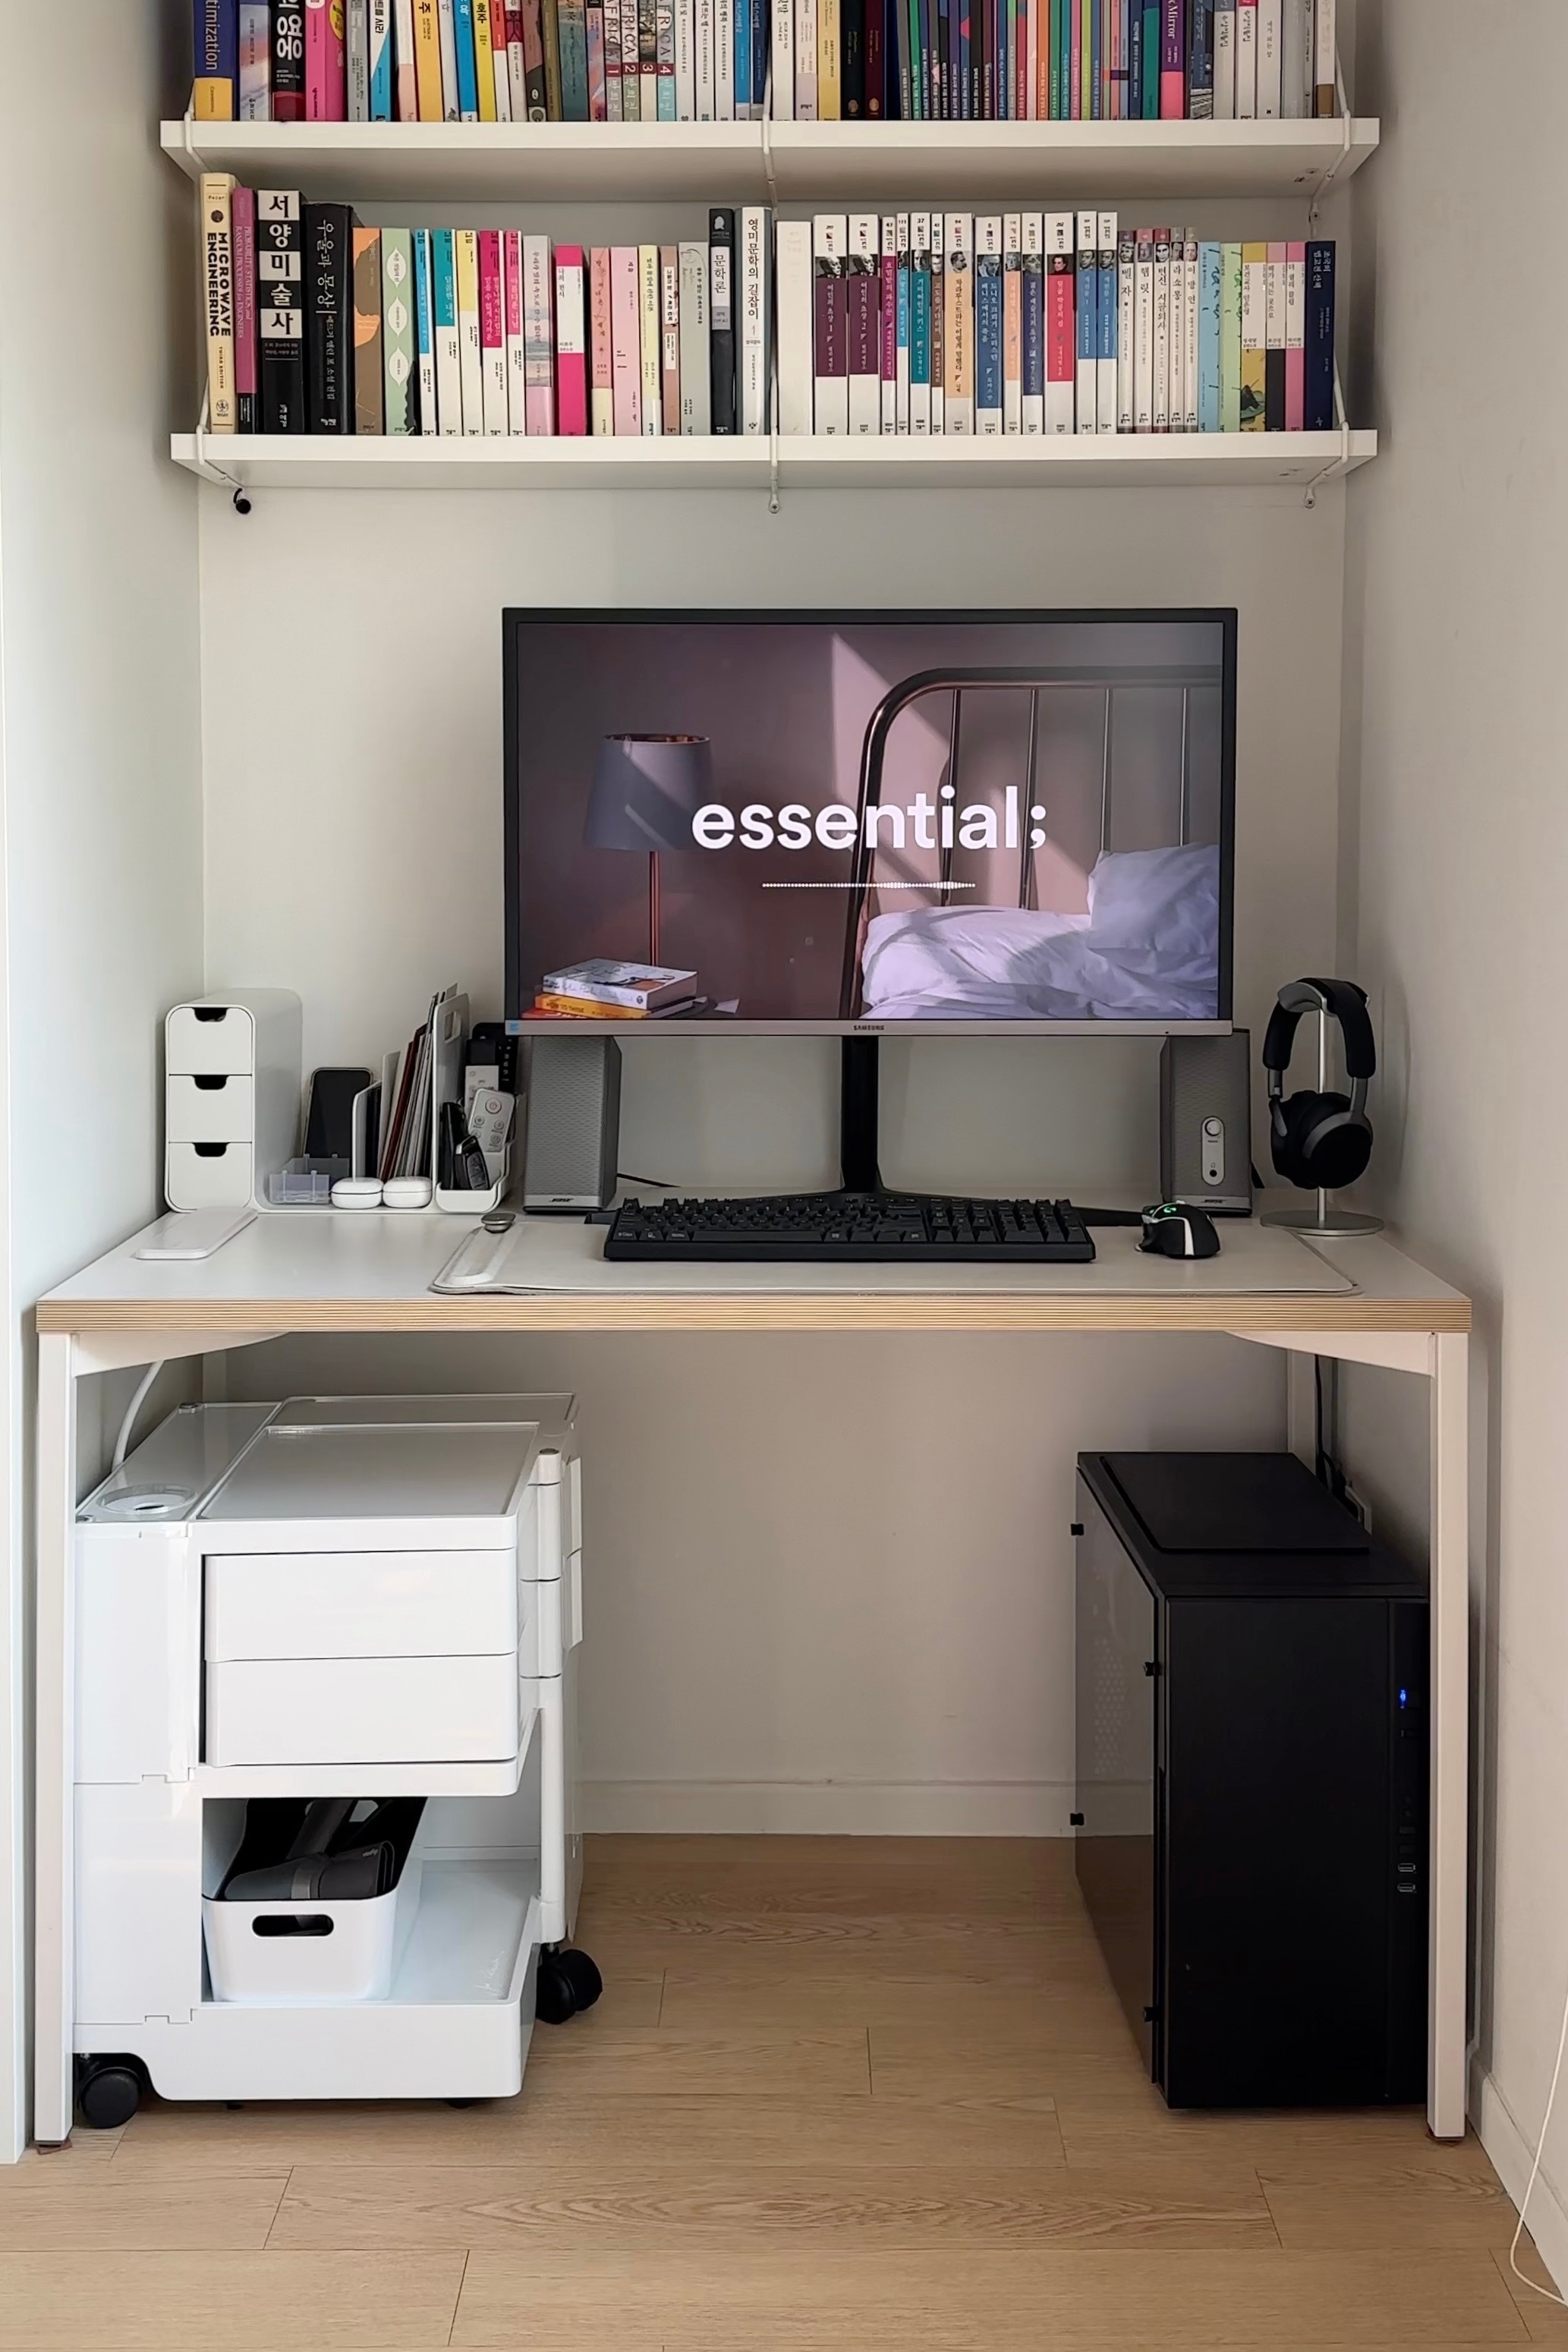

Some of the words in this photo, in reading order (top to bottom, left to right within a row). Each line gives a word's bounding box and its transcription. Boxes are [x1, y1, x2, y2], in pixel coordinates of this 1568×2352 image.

[276, 14, 303, 61] 영웅
[1168, 6, 1178, 39] Mirror
[269, 195, 294, 335] 서양미술사
[316, 219, 335, 267] 우울과
[748, 218, 759, 279] 영미문학의
[207, 232, 219, 337] ENGINEERING
[218, 232, 231, 337] MICROWAVE
[316, 275, 336, 308] 몽상
[713, 254, 726, 294] 문학론
[748, 283, 759, 320] 길잡이
[691, 785, 1048, 850] essential;
